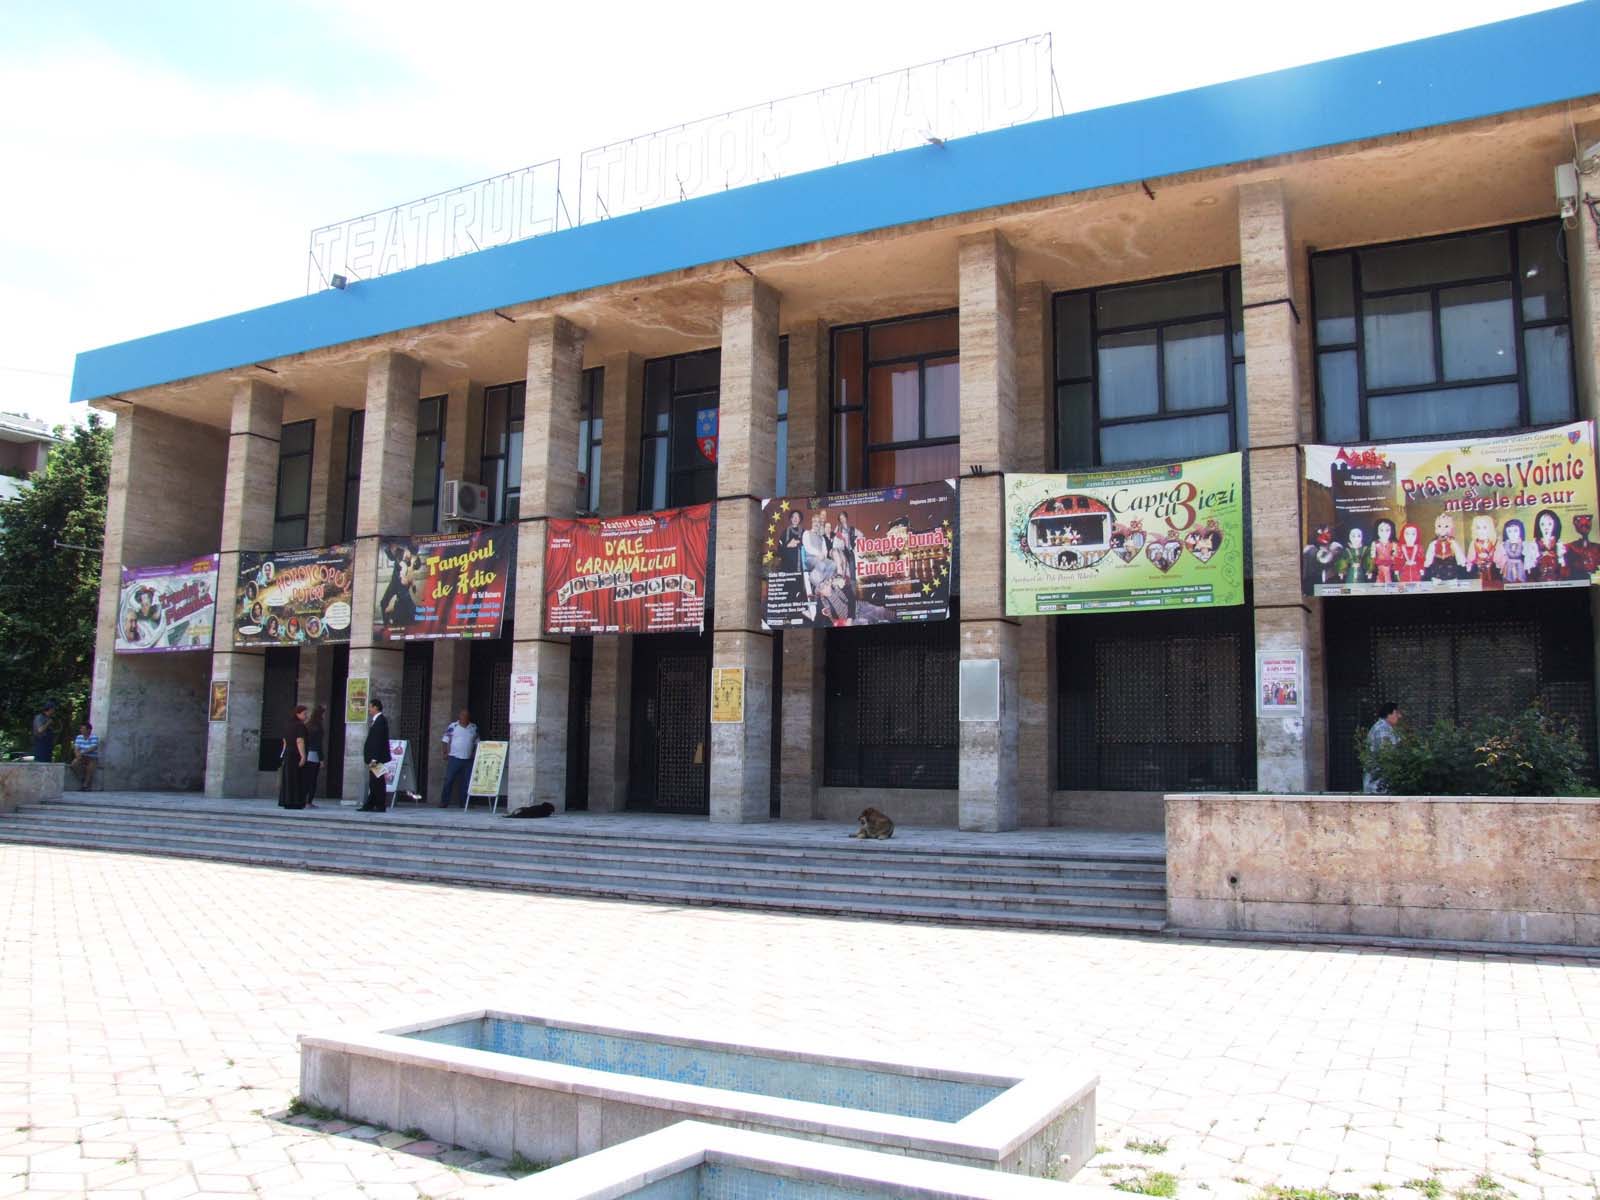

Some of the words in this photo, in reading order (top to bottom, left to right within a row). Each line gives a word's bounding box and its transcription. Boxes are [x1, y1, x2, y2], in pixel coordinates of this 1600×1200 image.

[311, 170, 553, 289] TEATRUL
[585, 106, 792, 220] TUDOR
[816, 38, 1049, 163] VIANU
[1482, 464, 1513, 488] cel
[1517, 453, 1584, 487] Voinic
[1111, 488, 1181, 513] Capra
[1155, 502, 1177, 518] cu
[1165, 482, 1197, 531] 3
[1199, 483, 1235, 510] iezi
[1444, 492, 1514, 513] merele
[1514, 490, 1537, 508] de
[1541, 490, 1575, 505] aur
[601, 519, 630, 529] Teatrul
[605, 536, 645, 556] D'ALE
[856, 535, 905, 555] Noapte
[908, 527, 949, 548] bună,
[426, 539, 495, 576] Tangoul
[857, 557, 910, 577] Europa!
[432, 581, 453, 599] de
[457, 570, 496, 594] Adio
